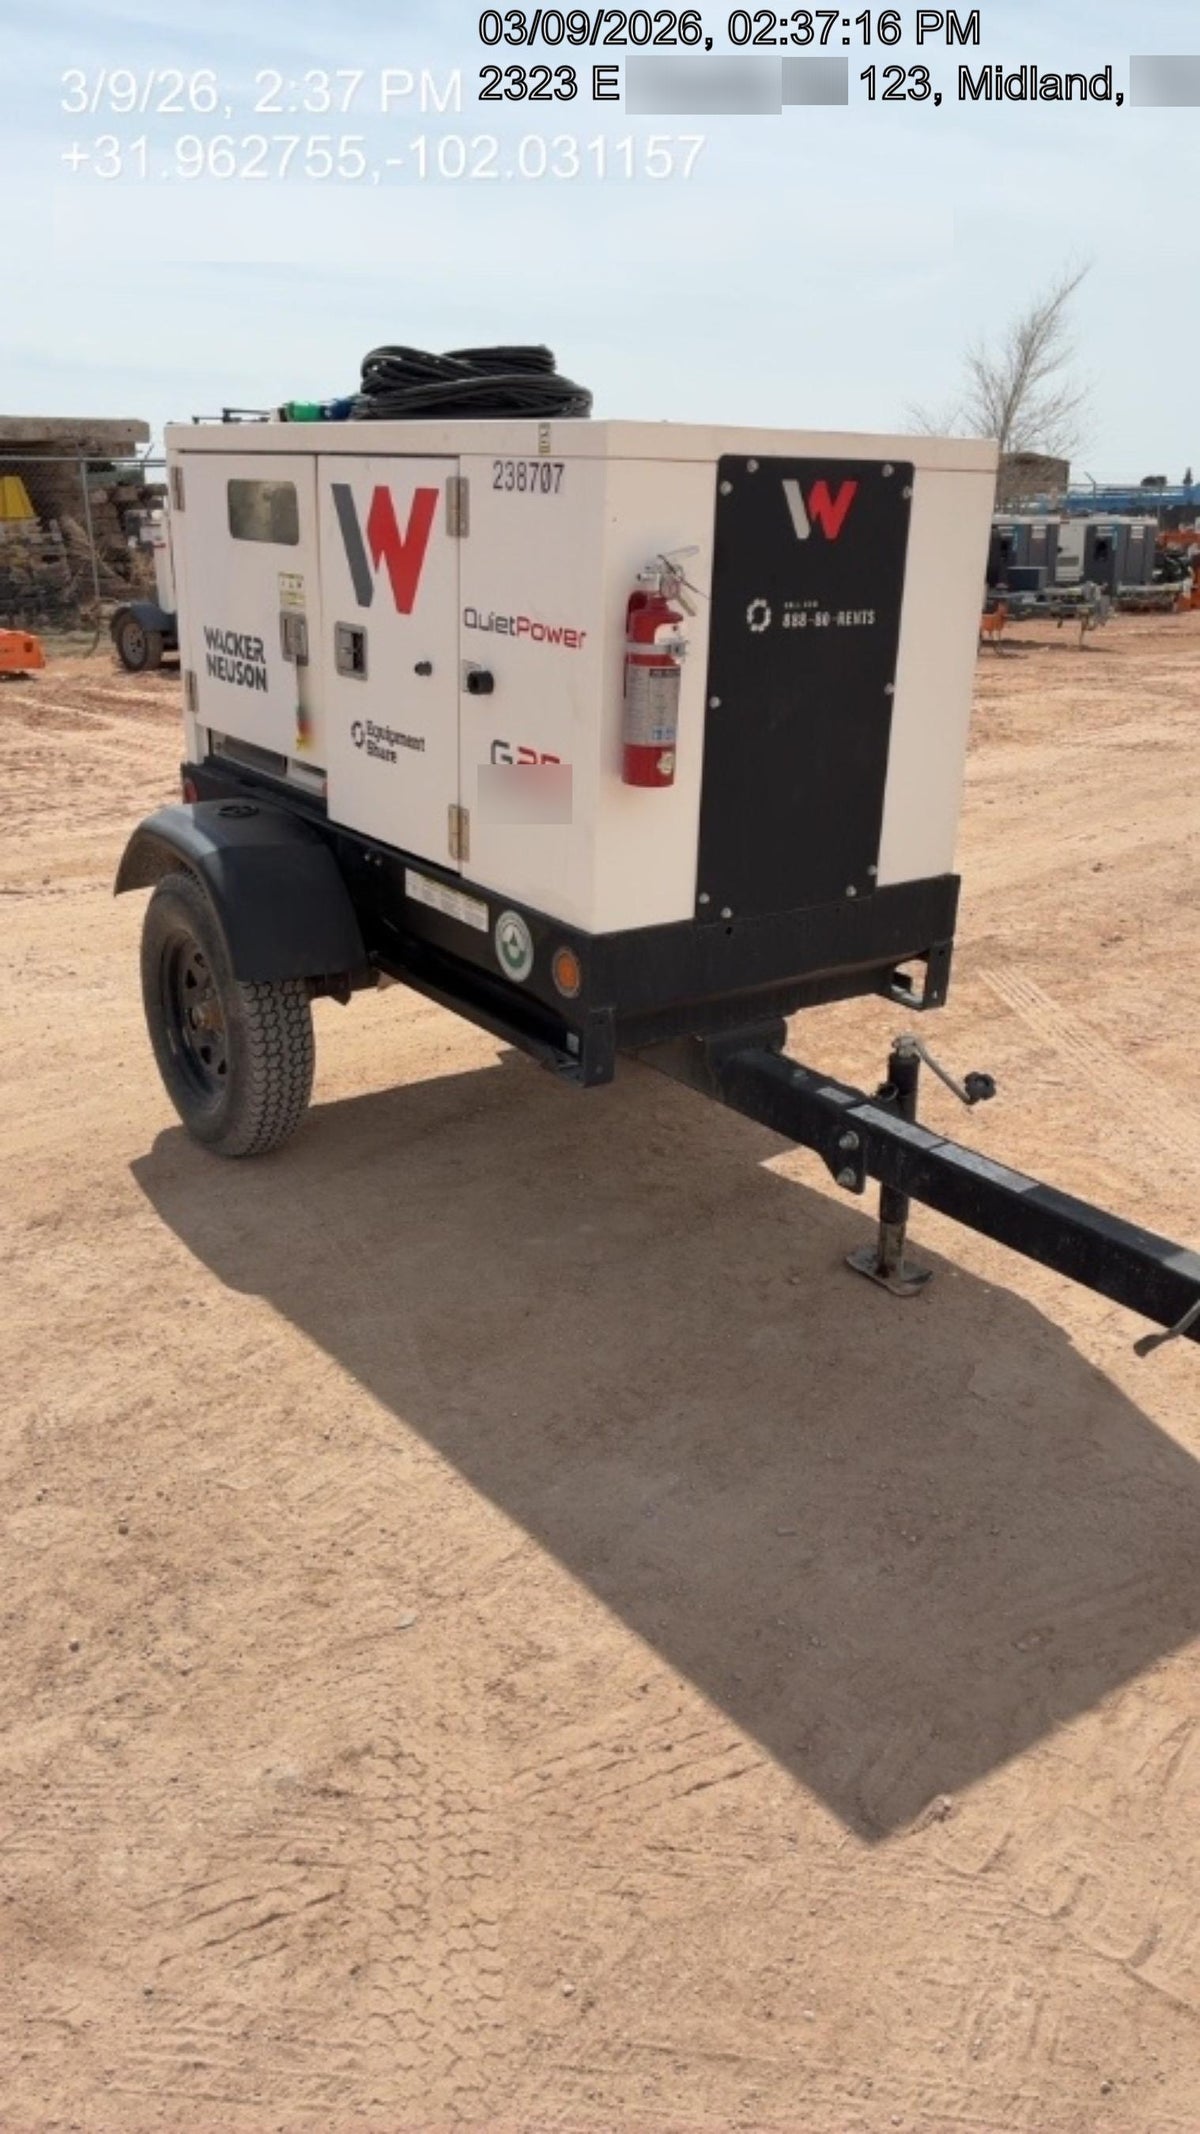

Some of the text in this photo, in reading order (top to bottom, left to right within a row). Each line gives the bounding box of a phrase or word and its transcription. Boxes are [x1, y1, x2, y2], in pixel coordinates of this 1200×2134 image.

[493, 460, 565, 494] 238707
[203, 625, 266, 664] WACKER
[464, 606, 587, 649] QuietPower
[206, 652, 269, 693] NEUSON
[366, 719, 425, 752] Equipment
